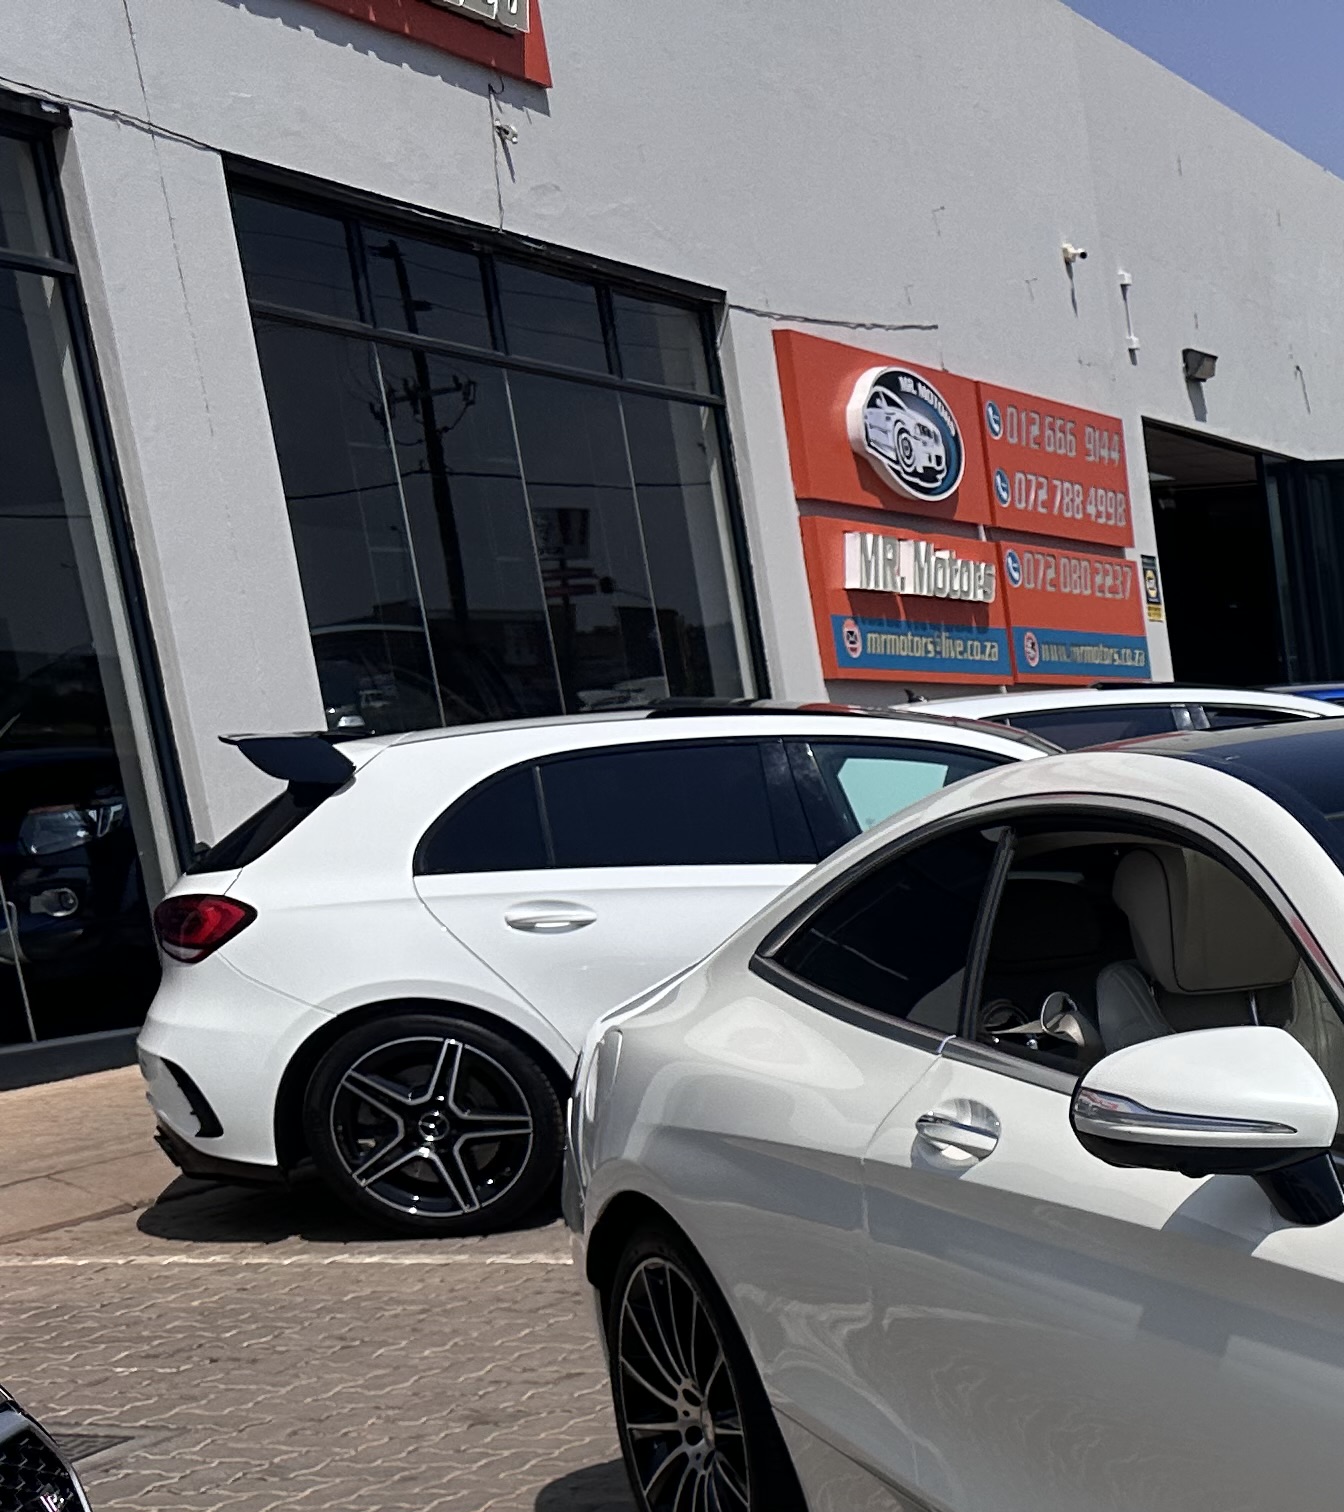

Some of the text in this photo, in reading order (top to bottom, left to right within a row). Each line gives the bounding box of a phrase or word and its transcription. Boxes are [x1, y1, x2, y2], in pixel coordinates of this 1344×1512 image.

[1007, 405, 1120, 467] 012 666 9144
[1014, 471, 1127, 527] 072 788 4998
[844, 532, 996, 603] MR. Motors
[1023, 551, 1056, 592] 072
[1060, 557, 1092, 596] 080
[1094, 561, 1132, 600] 2237
